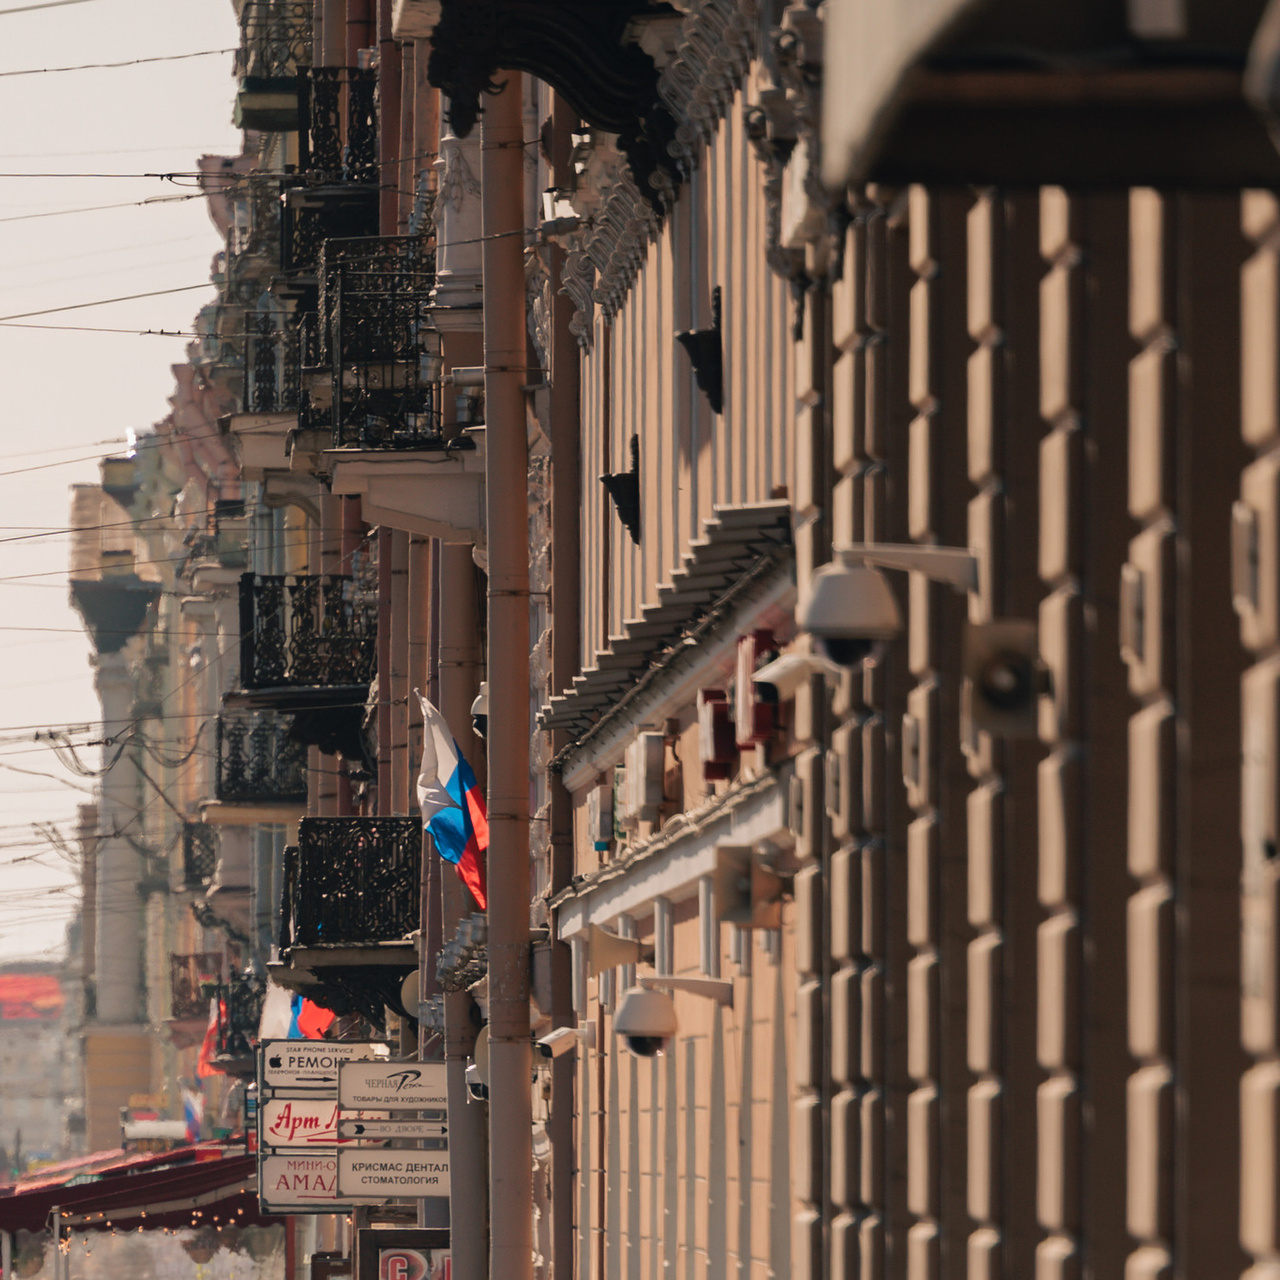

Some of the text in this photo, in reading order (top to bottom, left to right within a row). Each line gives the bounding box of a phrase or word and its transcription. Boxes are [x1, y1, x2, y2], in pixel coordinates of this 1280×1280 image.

[364, 1079, 398, 1089] ЧЕРНАЯ
[353, 1095, 382, 1103] ТОВАРЫ
[383, 1095, 399, 1103] ДЛЯ
[274, 1102, 321, 1142] Арт
[380, 1125, 424, 1134] ВО ДВОРЕ
[287, 1160, 337, 1171] МИНИ-О
[352, 1162, 449, 1173] КРИСМАС ДЕНТАЛ
[361, 1176, 439, 1185] СТОМАТОЛОГИЯ
